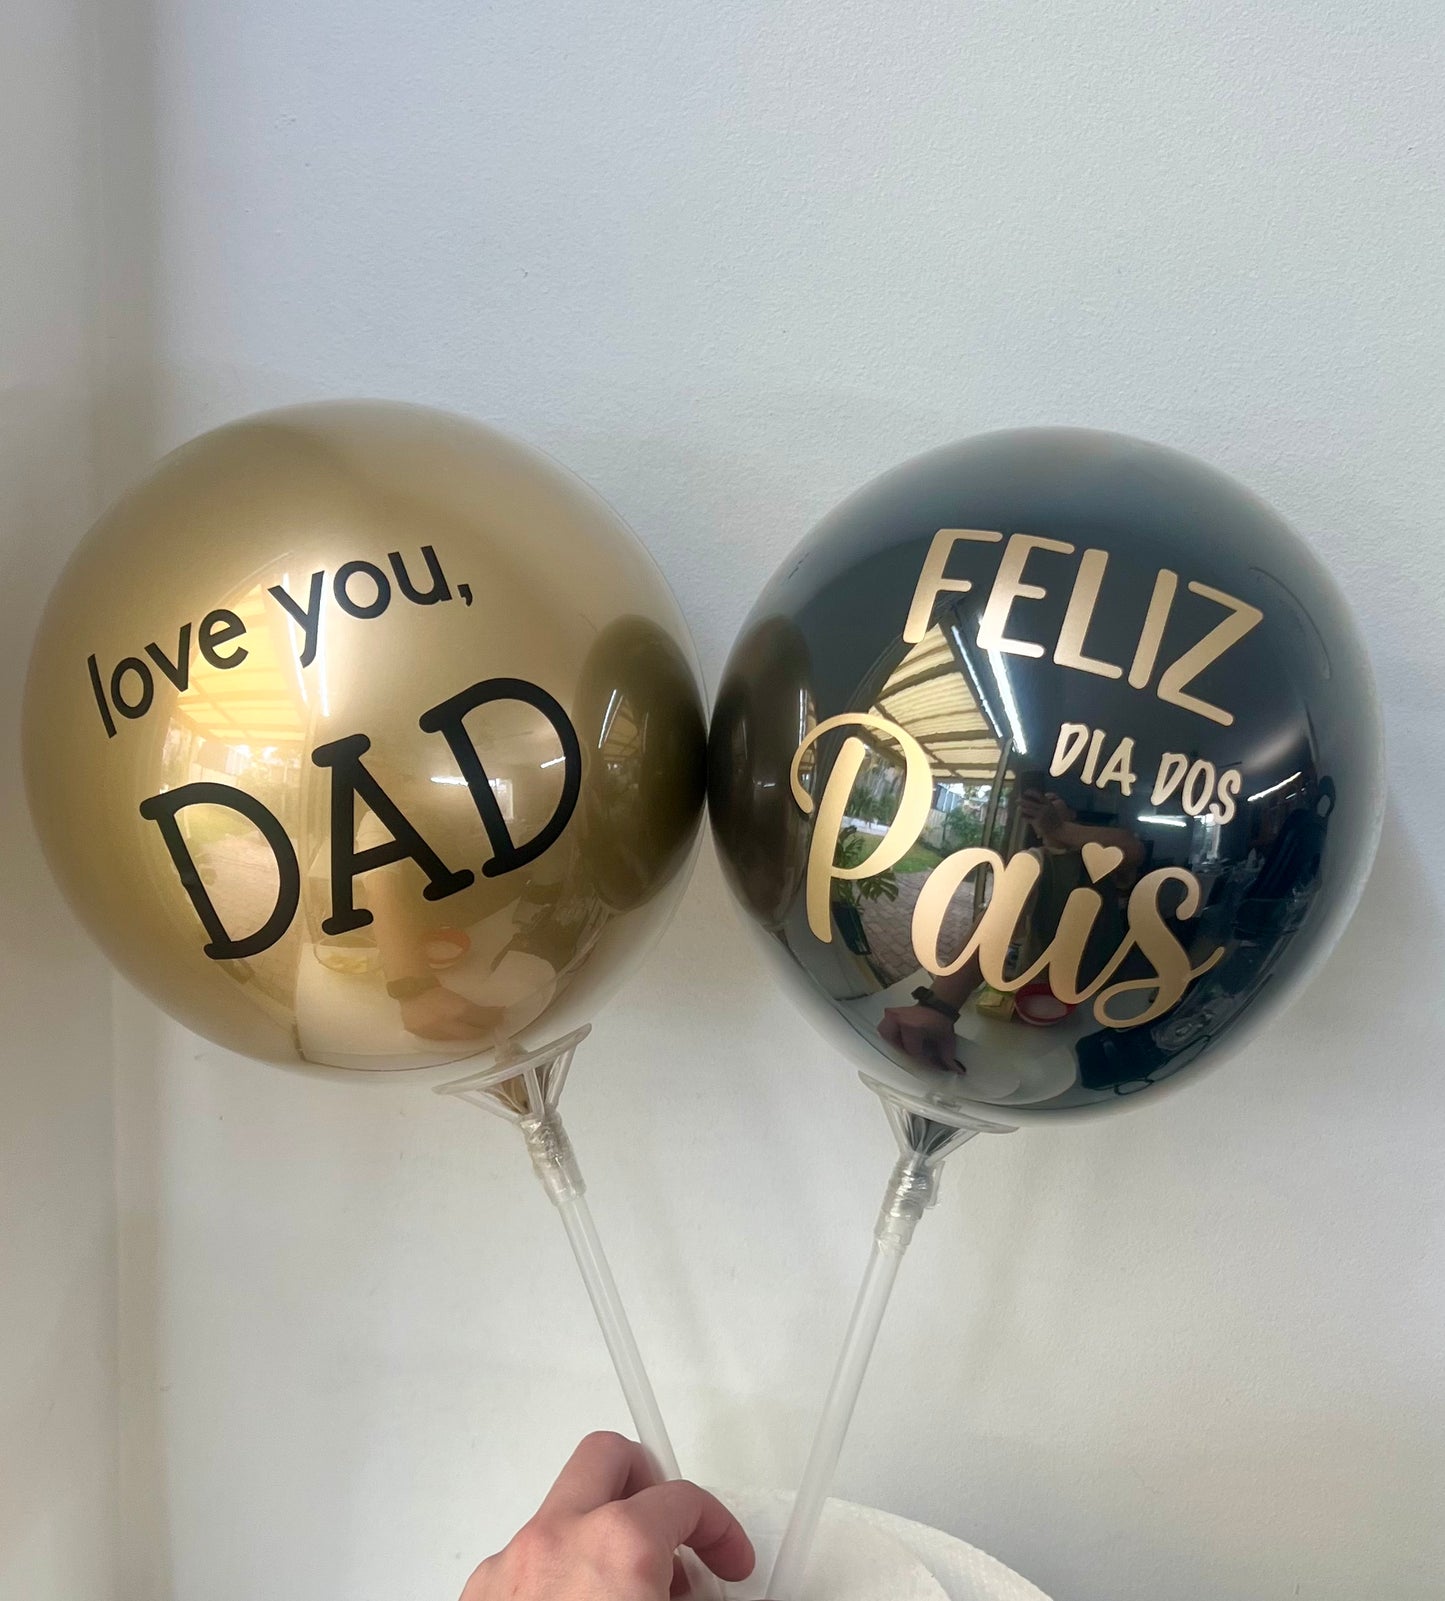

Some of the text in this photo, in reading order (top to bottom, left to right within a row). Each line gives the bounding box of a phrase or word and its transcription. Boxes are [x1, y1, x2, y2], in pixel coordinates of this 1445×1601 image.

[87, 545, 473, 739] love you,
[903, 528, 1264, 726] FELIZ
[139, 677, 582, 960] DAD
[790, 712, 1225, 1029] Pais
[1049, 722, 1241, 825] DIA DOS
